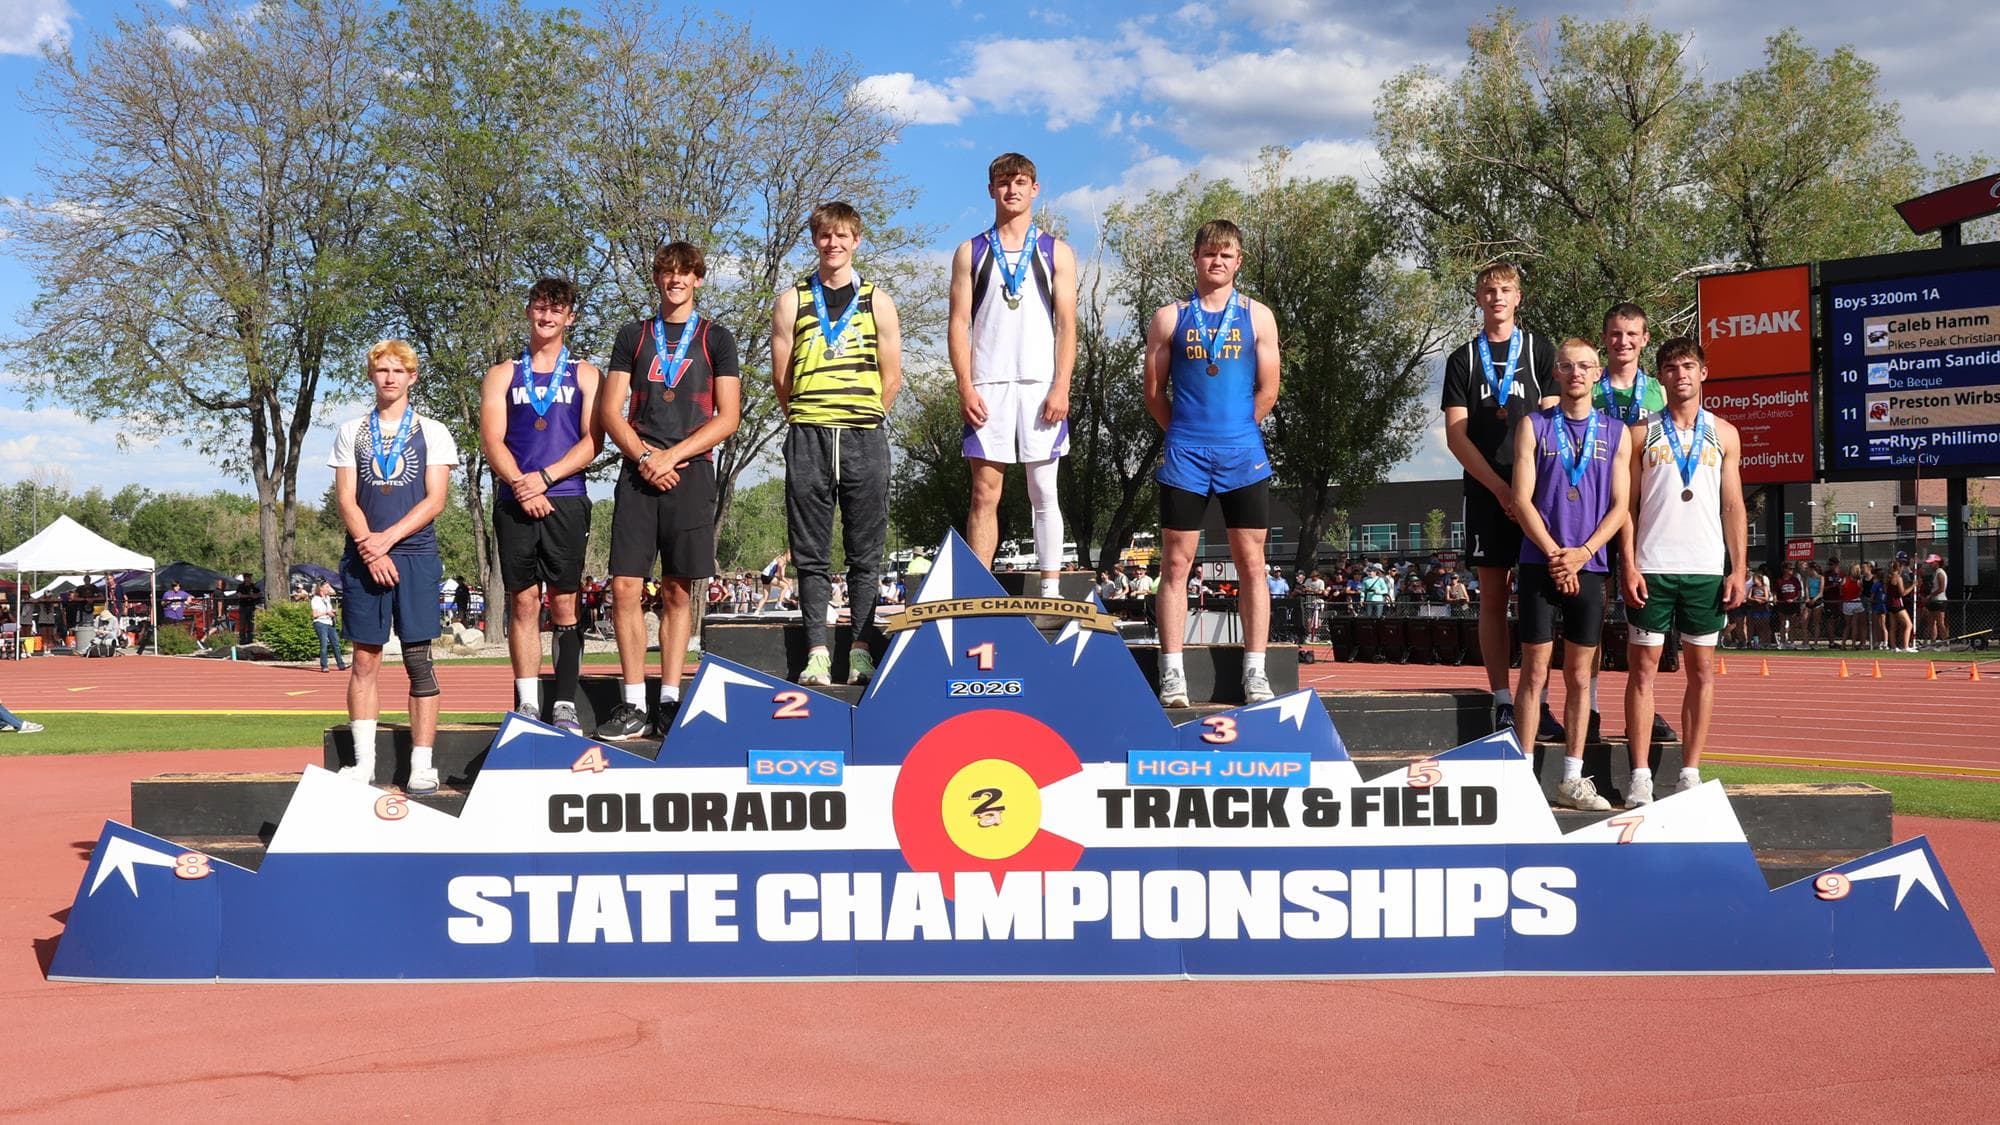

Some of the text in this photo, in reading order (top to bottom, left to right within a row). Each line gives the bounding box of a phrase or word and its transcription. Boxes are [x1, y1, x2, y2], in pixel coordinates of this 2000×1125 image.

[1834, 287, 1941, 311] Boys 3200m 1A
[1707, 309, 1802, 339] 1STBANK
[1887, 313, 1990, 334] Caleb Hamm
[1186, 328, 1242, 342] CUSR
[1843, 332, 1853, 345] 9
[1887, 332, 2000, 350] Pikes Peak Christian
[1186, 344, 1242, 360] COTY
[1887, 349, 2000, 373] Abram Sandid
[1840, 369, 1858, 383] 10
[1888, 376, 1943, 391] De Beque
[512, 387, 575, 405] WRAY
[1480, 379, 1525, 400] LIN
[1703, 389, 1809, 410] CO Prep Spotlight
[1889, 390, 2000, 410] Preston Wirbs
[1766, 409, 1794, 419] Athletics
[1840, 407, 1858, 421] 11
[1889, 415, 1929, 427] Merino
[1542, 437, 1608, 461] LE
[1889, 430, 2000, 449] Rhys Phillimo
[1842, 444, 1860, 458] 12
[1889, 452, 1941, 466] Lake City
[1472, 534, 1485, 557] L
[1214, 562, 1225, 577] 9
[911, 598, 1093, 617] STATE CHAMPION
[967, 642, 996, 671] 1
[950, 679, 1023, 697] 2026
[772, 691, 811, 719] 2
[1200, 716, 1240, 744] 3
[571, 746, 611, 773] 4
[755, 759, 838, 777] BOYS
[1137, 759, 1303, 779] HIGH JUMP
[1405, 758, 1443, 788] 5
[374, 793, 410, 822] 6
[548, 791, 847, 834] COLORADO
[1097, 785, 1498, 829] TRACK & FIELD
[1607, 815, 1646, 845] 7
[173, 851, 211, 880] 8
[1812, 871, 1851, 900] 9
[447, 866, 1577, 944] STATE CHAMPIONSHIPS
